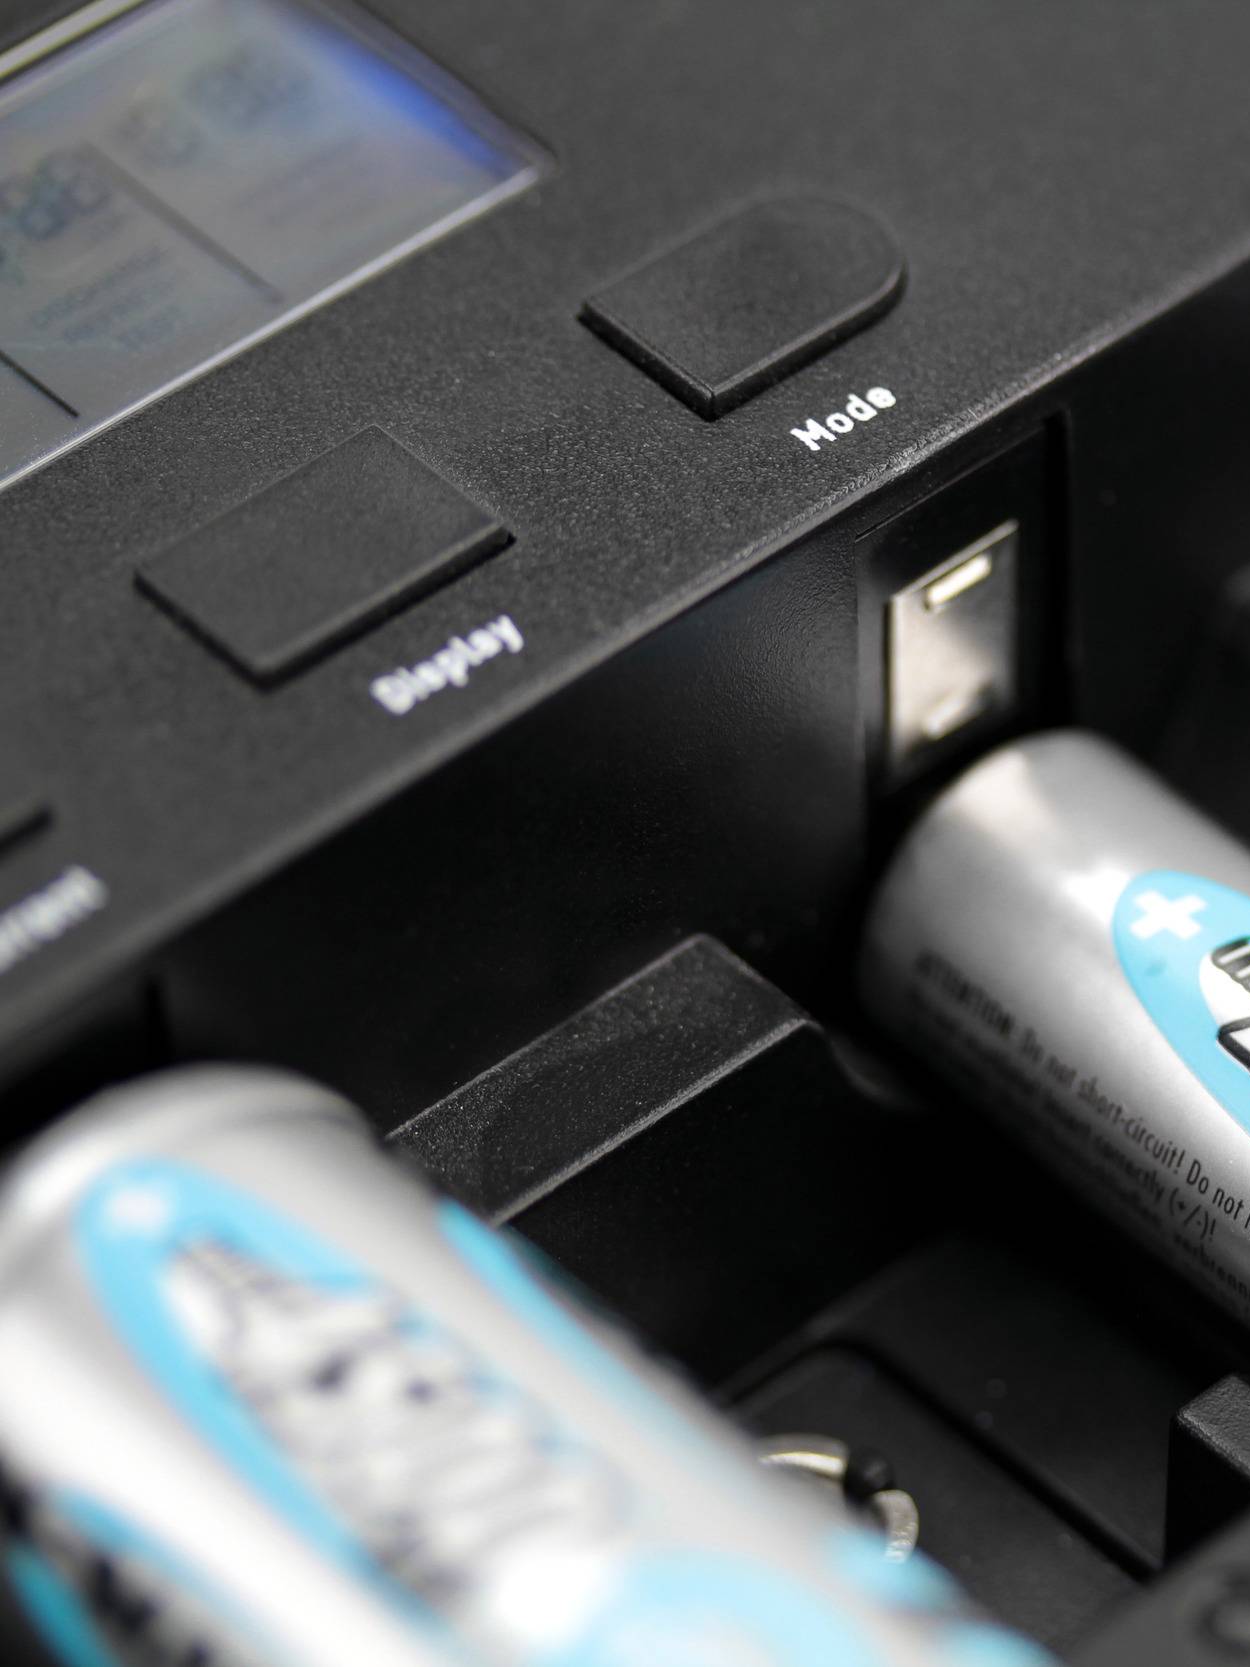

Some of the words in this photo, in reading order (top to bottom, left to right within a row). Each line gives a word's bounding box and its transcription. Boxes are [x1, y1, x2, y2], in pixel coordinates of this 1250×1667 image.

[789, 386, 898, 451] Mode
[1076, 1075, 1186, 1175] short-circuit!
[1186, 1159, 1209, 1194] Do
[1212, 1187, 1245, 1221] not
